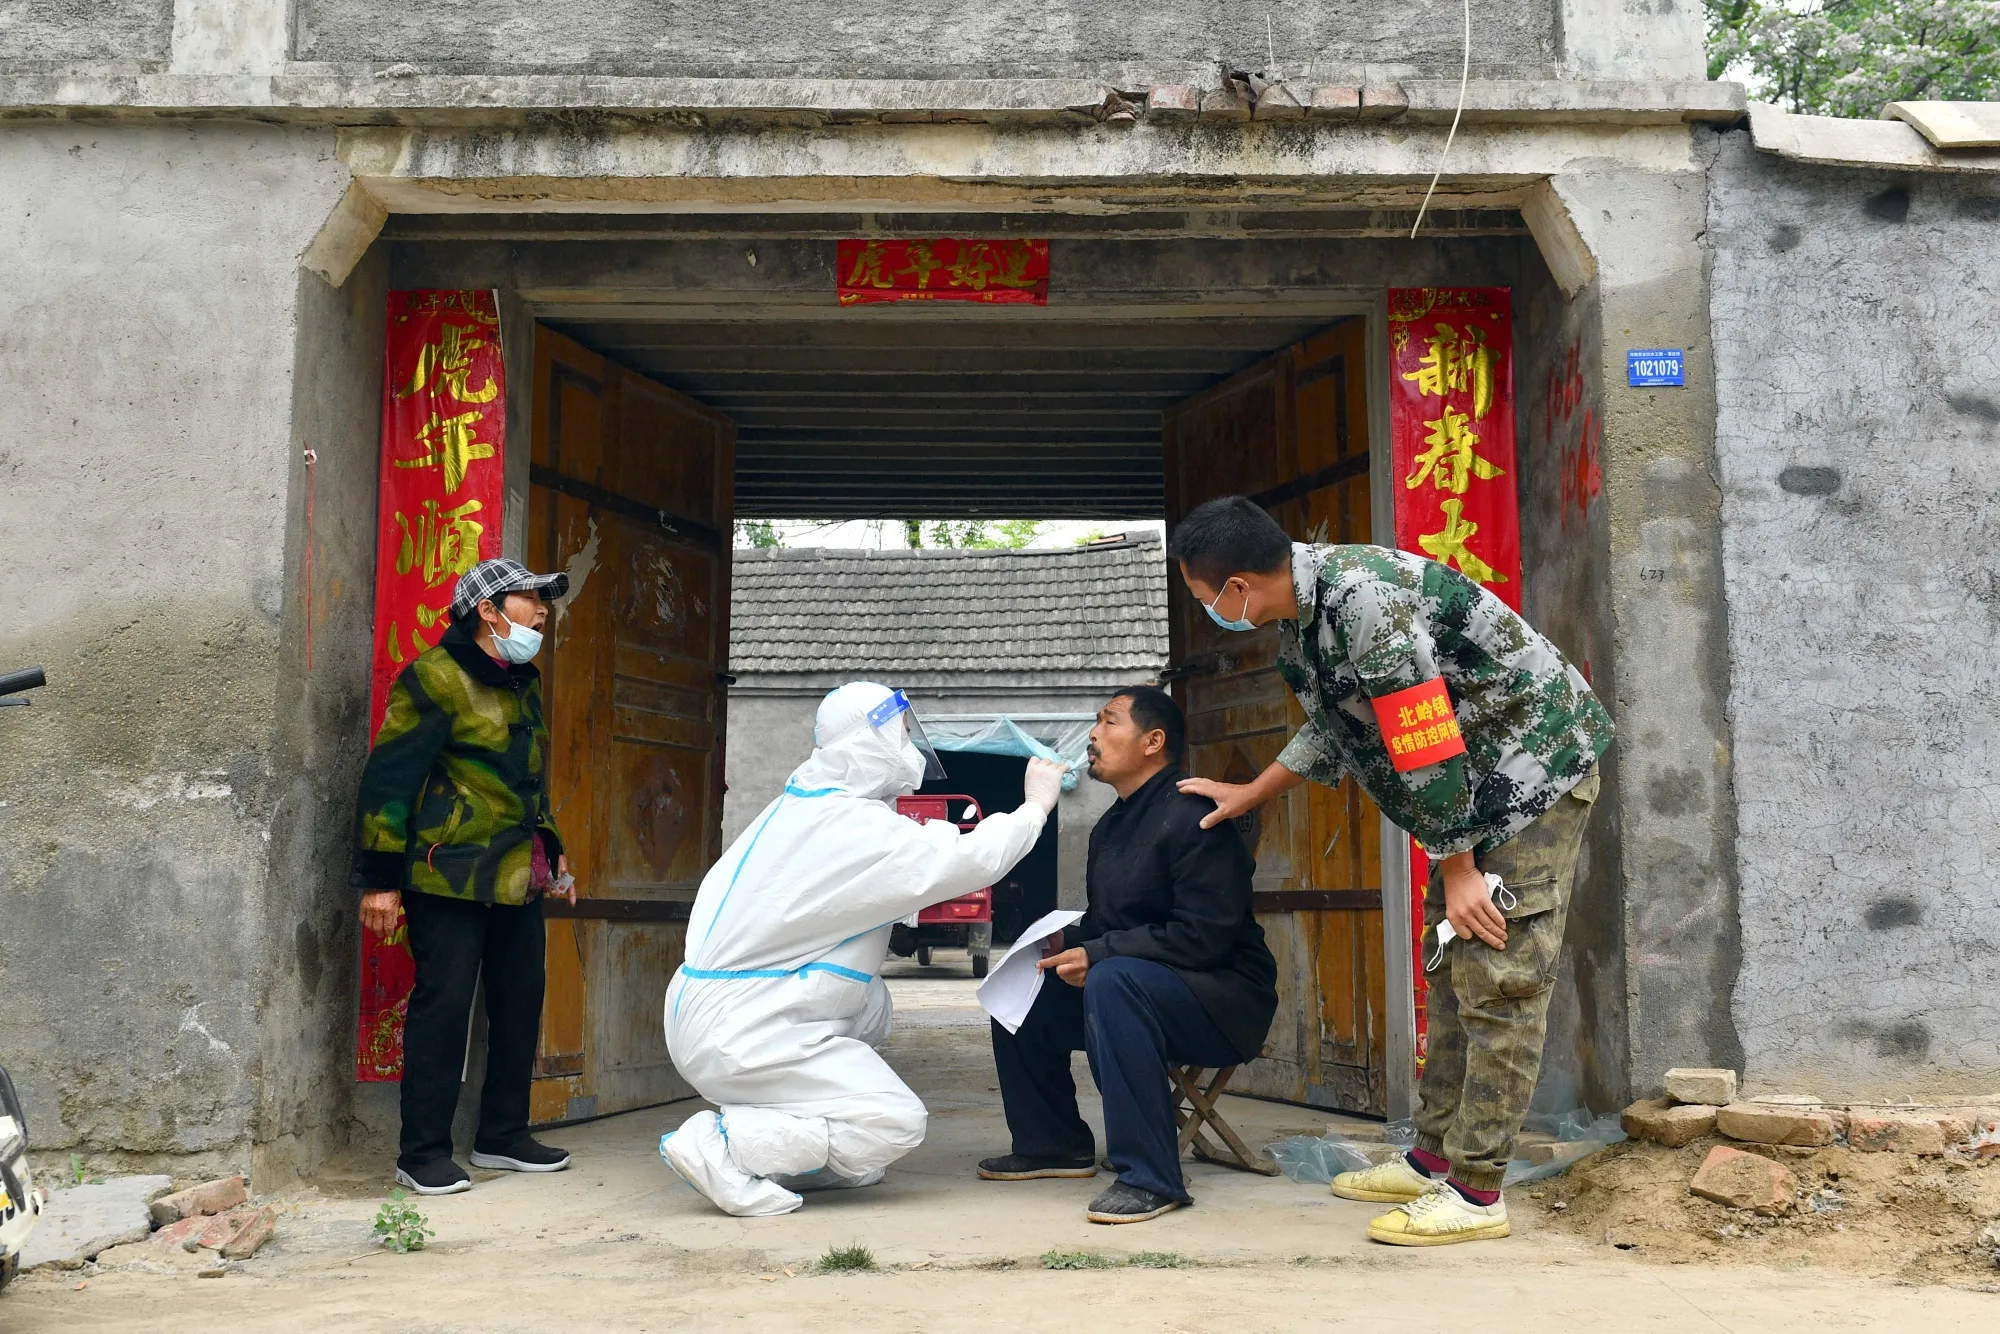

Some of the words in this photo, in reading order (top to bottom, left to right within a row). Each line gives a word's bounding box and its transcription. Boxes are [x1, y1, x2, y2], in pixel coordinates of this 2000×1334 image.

[1634, 359, 1679, 377] 1021079
[1398, 694, 1450, 728] 北岭镇
[1391, 718, 1461, 755] 疫情防控网格
